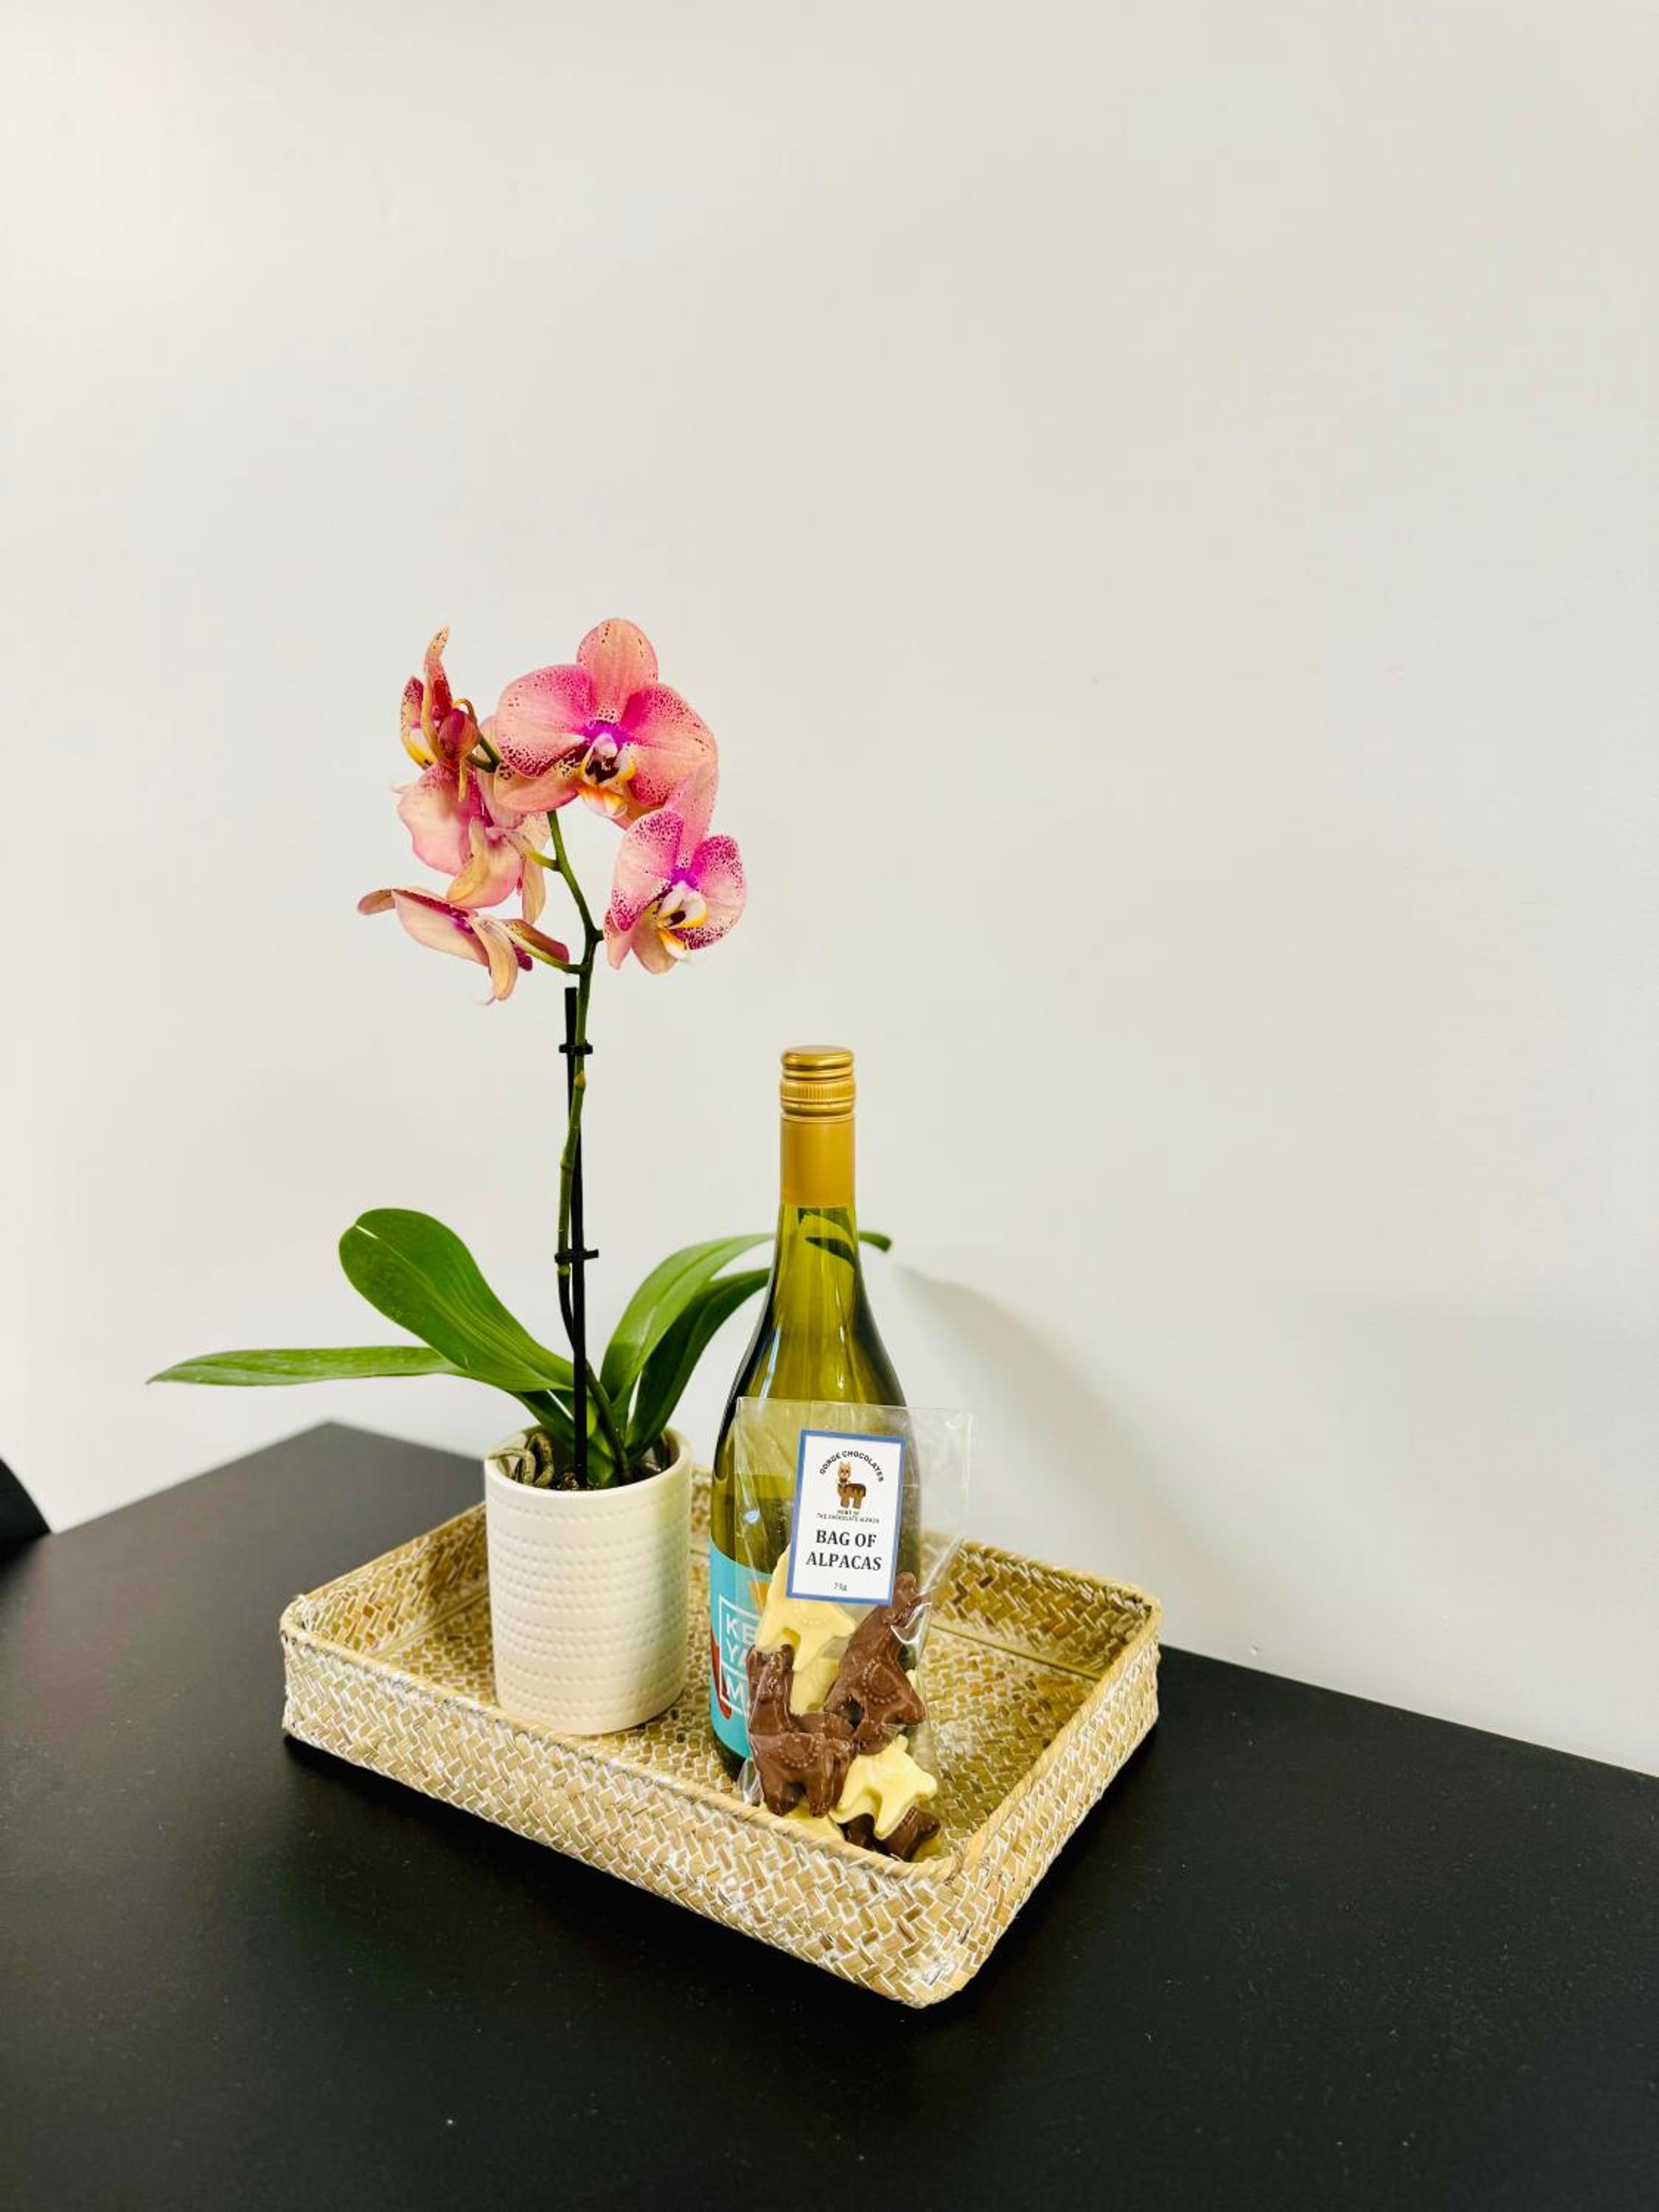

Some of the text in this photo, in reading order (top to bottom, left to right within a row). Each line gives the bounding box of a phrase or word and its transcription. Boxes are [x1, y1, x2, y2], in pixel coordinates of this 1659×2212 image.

[841, 1450, 884, 1482] CHOCOLATES
[815, 1529, 877, 1548] BAG OF
[806, 1551, 883, 1571] ALPACAS
